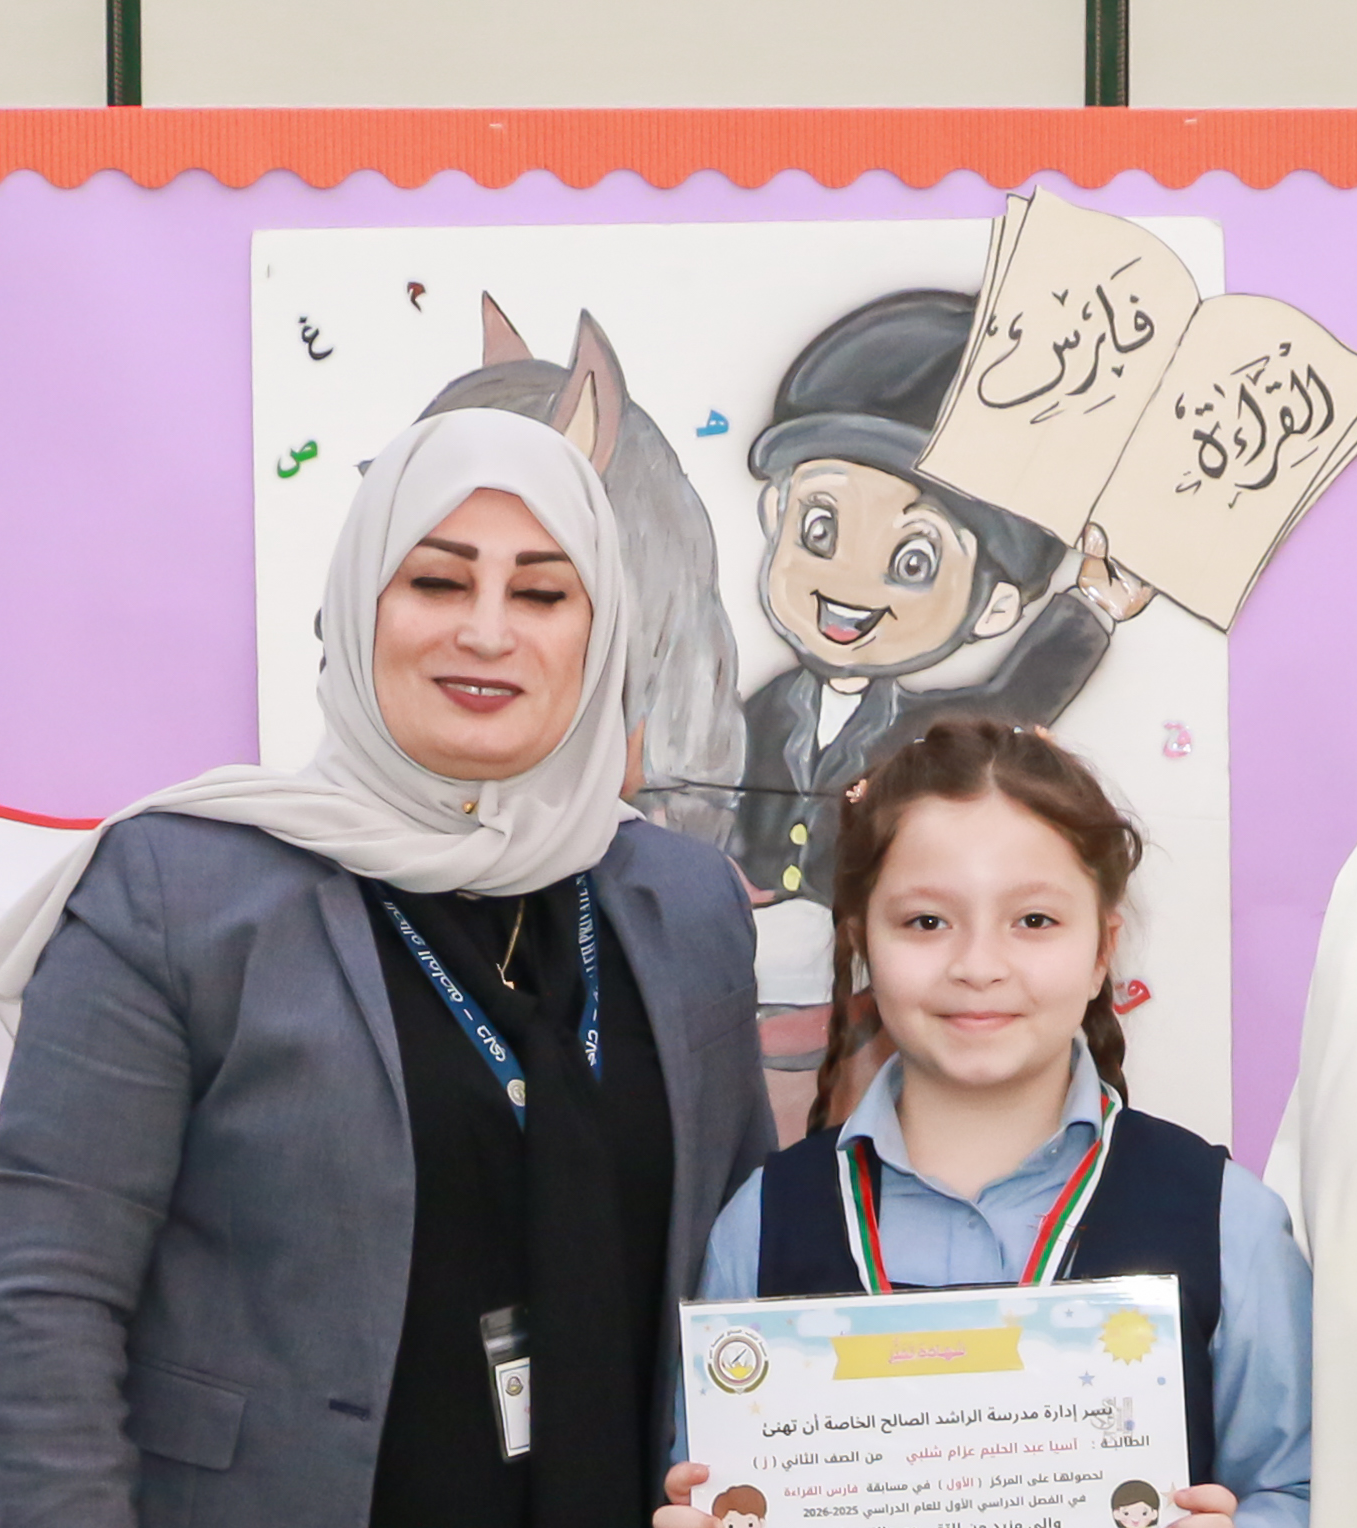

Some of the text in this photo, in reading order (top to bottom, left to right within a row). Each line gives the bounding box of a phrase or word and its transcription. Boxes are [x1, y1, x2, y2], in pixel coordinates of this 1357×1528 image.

[277, 440, 318, 478] ص
[936, 1410, 981, 1426] الراشد
[988, 1407, 1038, 1424] مدرسة
[1044, 1404, 1076, 1422] إدارة
[803, 1414, 819, 1435] أن
[825, 1415, 875, 1430] الخاصة
[881, 1412, 929, 1434] الصالح
[980, 1443, 1017, 1459] الحليم
[1023, 1443, 1044, 1455] عبد
[782, 1453, 818, 1471] الثاني
[824, 1451, 859, 1463] الصف
[864, 1452, 883, 1464] من
[990, 1475, 1022, 1488] المركز
[1027, 1474, 1049, 1486] على
[1054, 1471, 1102, 1483] لحصولها
[784, 1486, 821, 1498] القراءة
[827, 1484, 858, 1497] فارس
[867, 1482, 908, 1493] مسابقة
[912, 1480, 930, 1495] في
[946, 1499, 972, 1512] الأول
[978, 1497, 1024, 1512] الدراسي
[1029, 1495, 1063, 1508] الفصل
[1068, 1495, 1086, 1507] في
[863, 1503, 909, 1519] الدراسي
[914, 1502, 940, 1514] للعام
